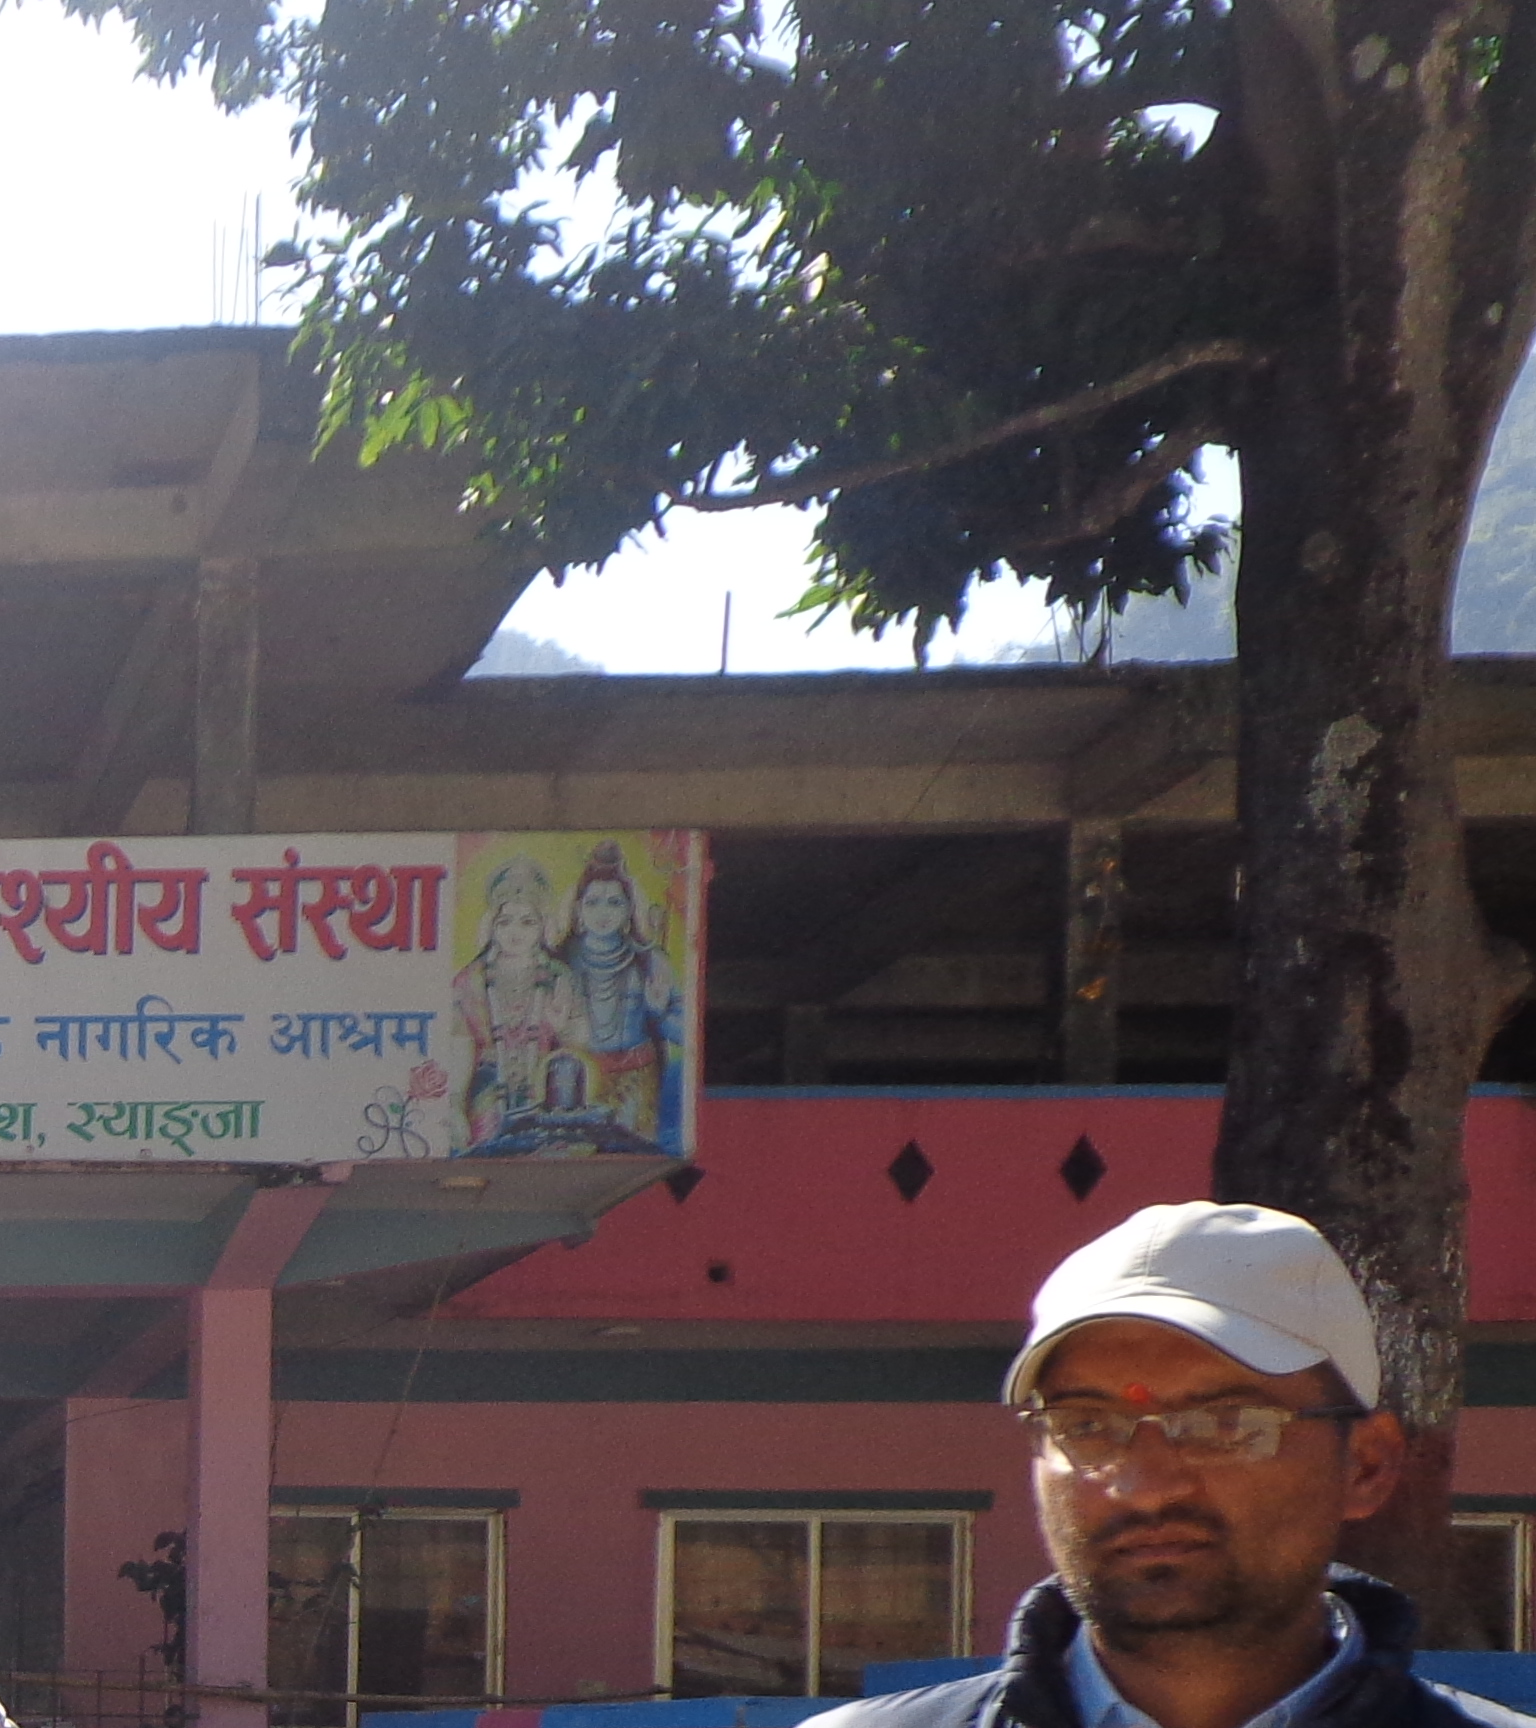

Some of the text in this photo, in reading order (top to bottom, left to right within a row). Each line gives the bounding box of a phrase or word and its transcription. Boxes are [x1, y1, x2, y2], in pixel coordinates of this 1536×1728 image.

[231, 847, 447, 961] संस्था
[35, 995, 245, 1064] नागरिक
[270, 1011, 438, 1059] आश्रम
